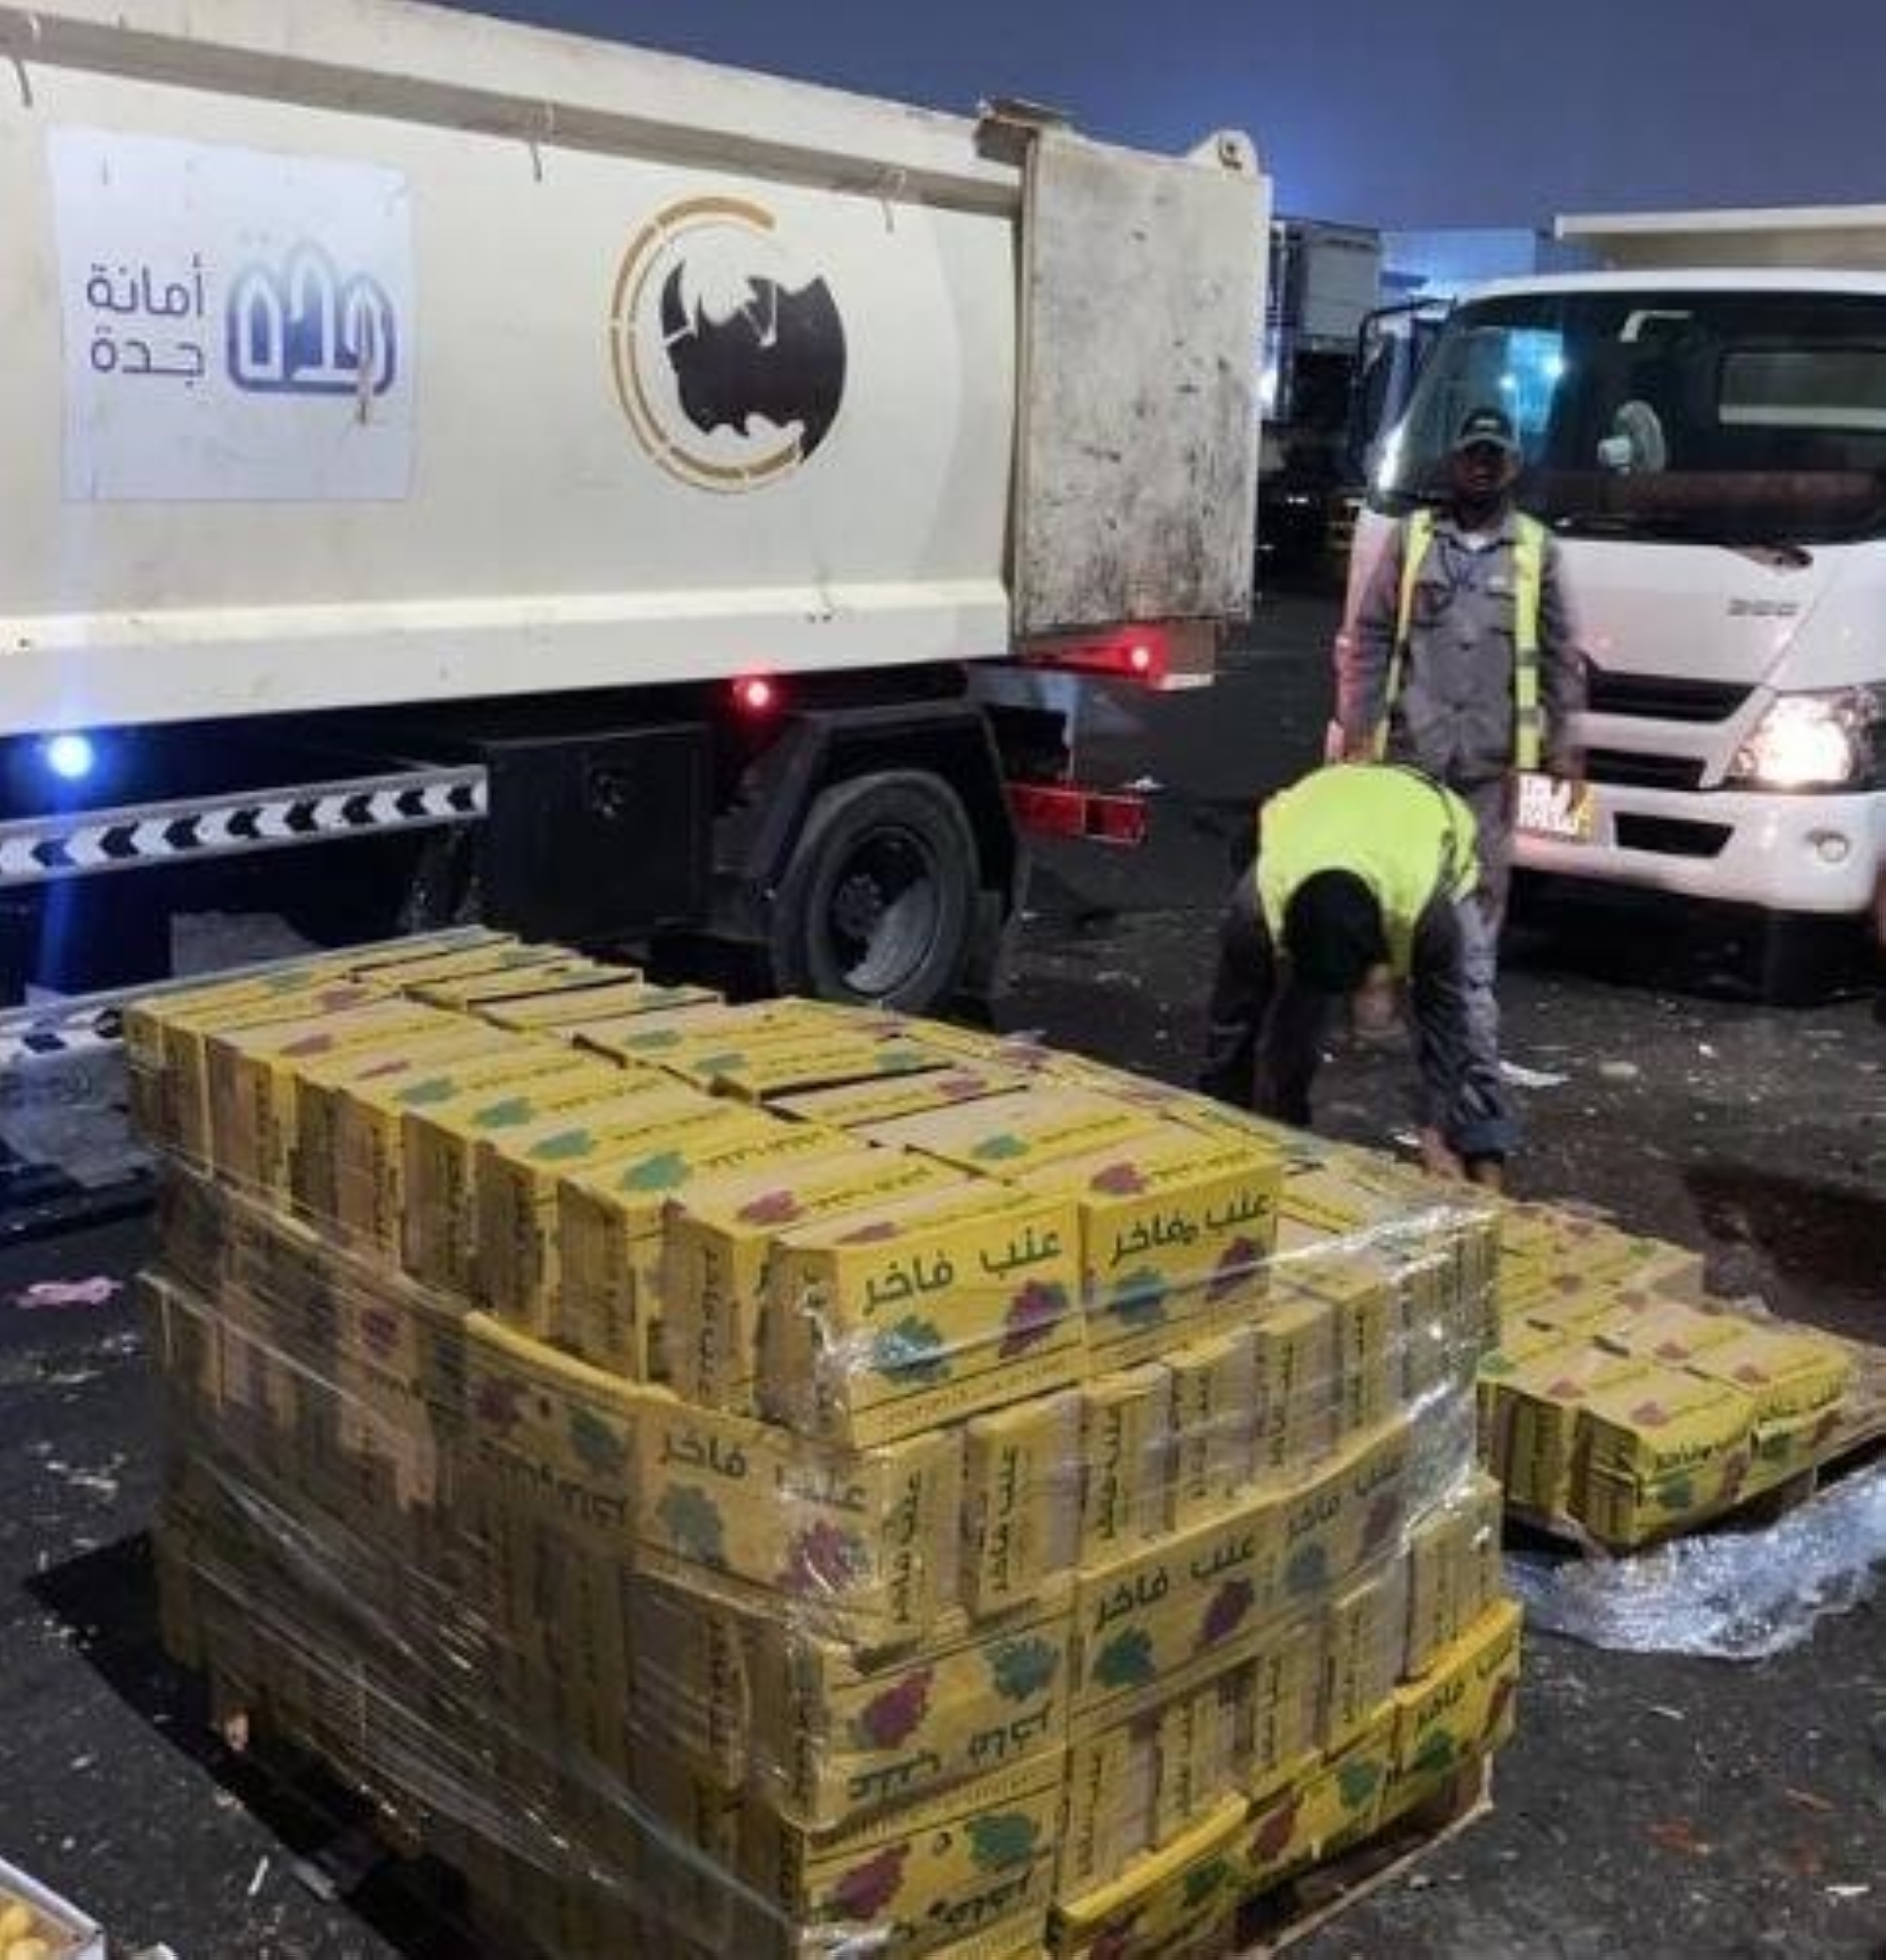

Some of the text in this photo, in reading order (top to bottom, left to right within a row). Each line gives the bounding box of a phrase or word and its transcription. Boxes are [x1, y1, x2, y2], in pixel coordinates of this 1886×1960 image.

[87, 252, 205, 319] أمانة
[91, 325, 205, 390] جدة
[1204, 1189, 1272, 1236] عنب
[862, 1226, 1063, 1316] عنب فاخر
[659, 1430, 748, 1479] فاخر
[1095, 1536, 1254, 1631] عنب فاخر
